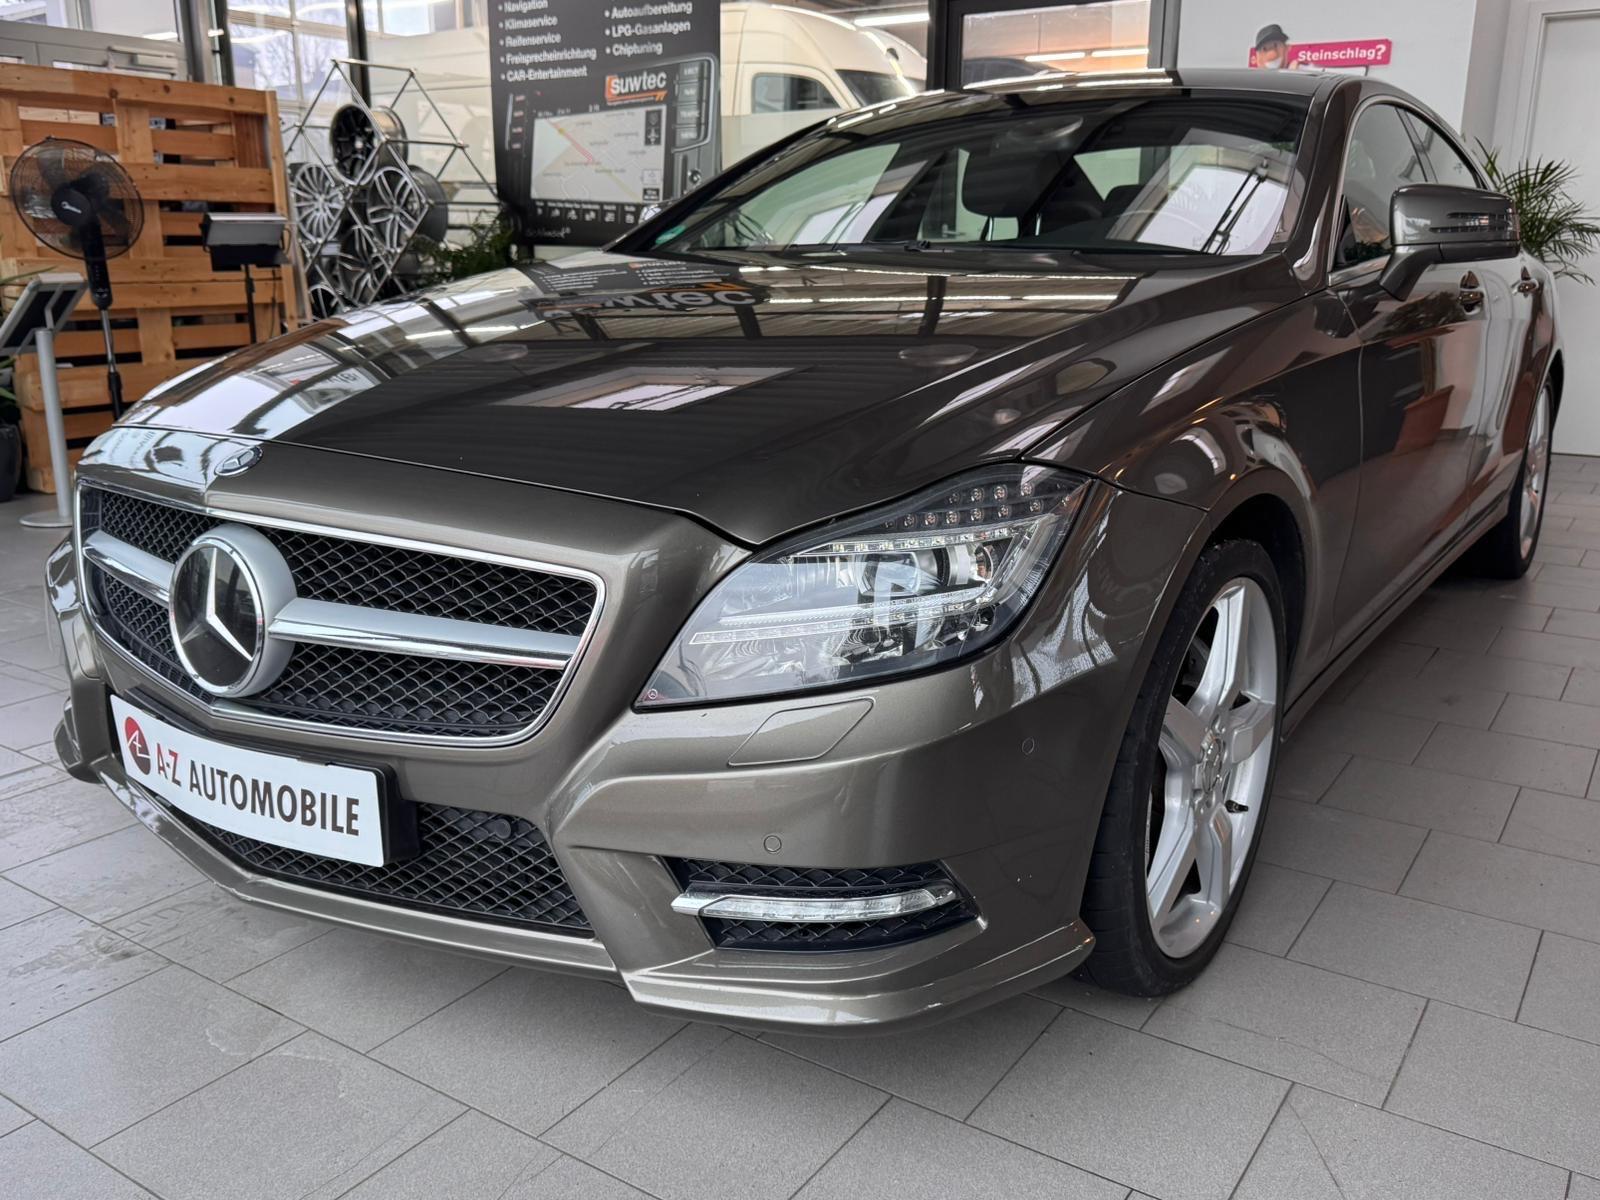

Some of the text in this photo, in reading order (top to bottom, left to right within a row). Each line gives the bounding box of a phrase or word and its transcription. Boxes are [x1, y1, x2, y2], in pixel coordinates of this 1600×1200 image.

[504, 0, 548, 13] Navigation
[611, 1, 693, 19] Autoaufbereitung
[505, 15, 558, 30] Klimaservice
[612, 20, 691, 38] LPG-Gasanlagen
[505, 32, 561, 48] Reifenservice
[506, 47, 597, 65] Freisprecheinrichtung
[612, 41, 663, 58] Chiptuning
[1297, 44, 1386, 62] Steinschlag?
[506, 65, 587, 82] CAR-Entertainment
[610, 70, 667, 95] suwtec
[156, 742, 360, 837] A-Z AUTOMOBILE
